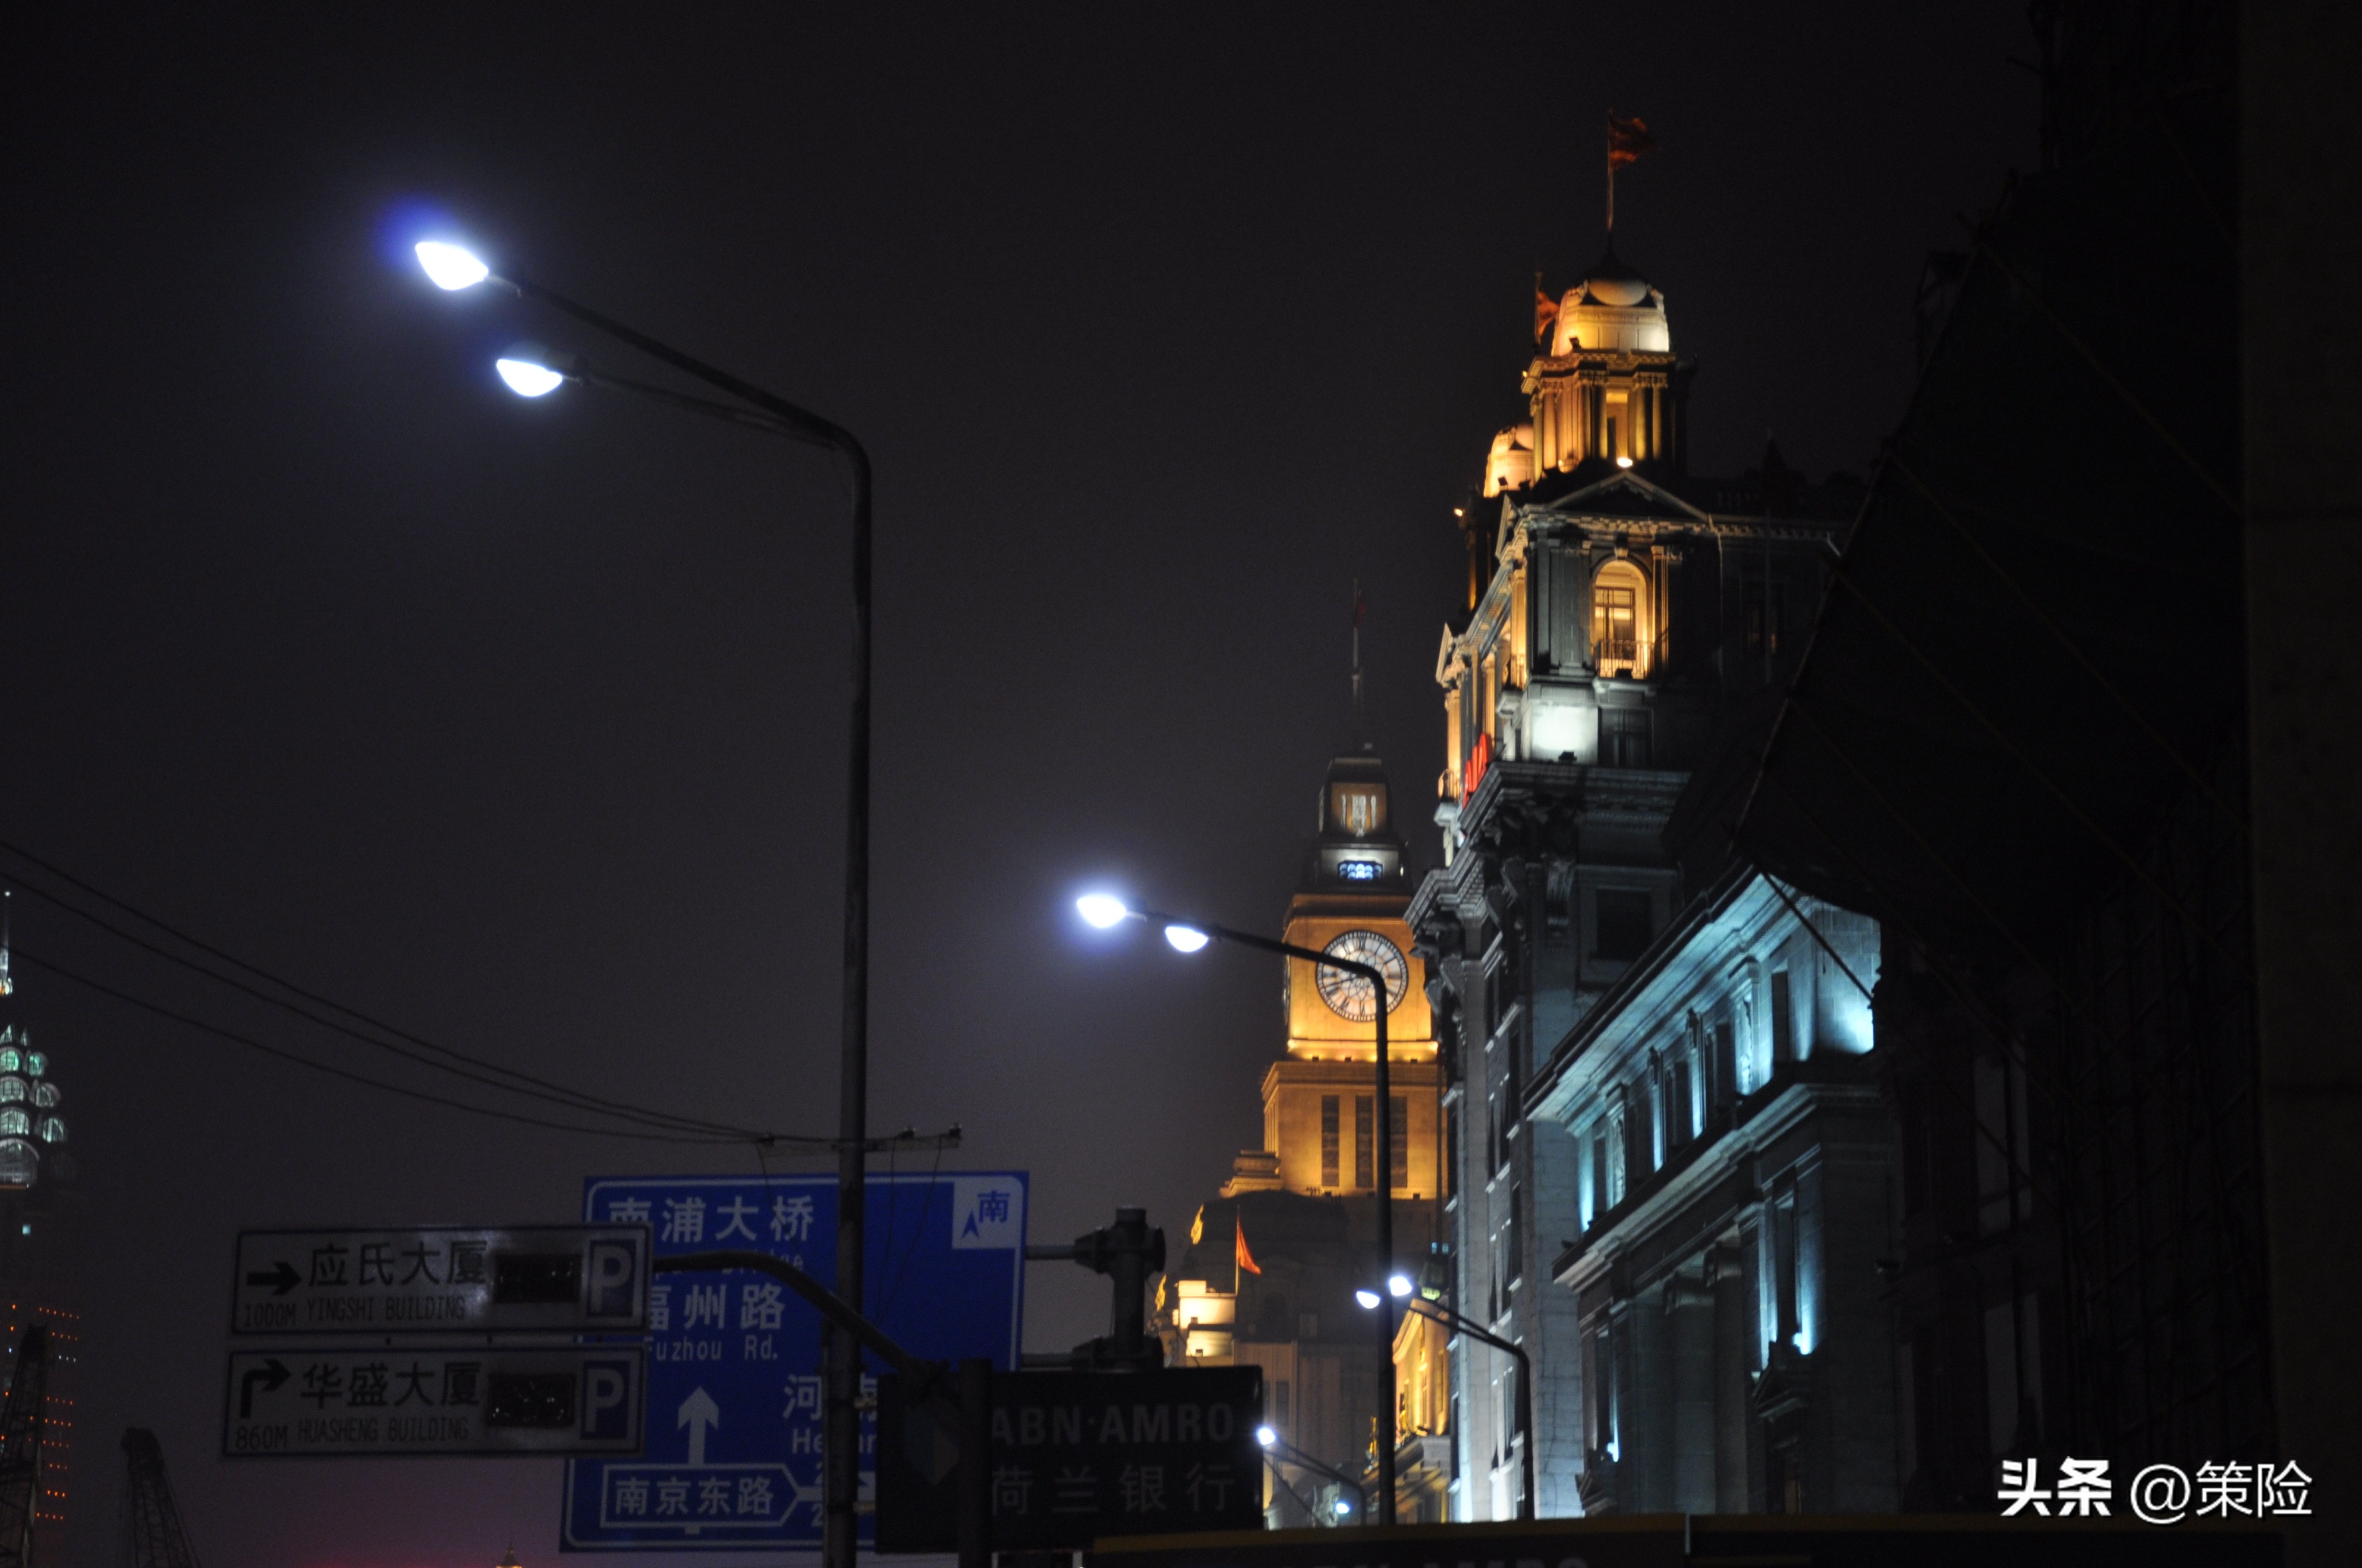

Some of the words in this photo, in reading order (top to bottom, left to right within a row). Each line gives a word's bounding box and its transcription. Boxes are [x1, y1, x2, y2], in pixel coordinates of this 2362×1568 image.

[609, 1194, 814, 1243] 南浦大桥
[978, 1191, 1009, 1223] 南
[309, 1241, 488, 1287] 应氏大厦
[595, 1245, 633, 1314] P
[244, 1303, 297, 1327] 1000M
[307, 1297, 374, 1323] YINGSHI
[386, 1296, 466, 1321] BUILDING
[744, 1334, 778, 1361] Rd.
[300, 1361, 482, 1409] 华盛大厦
[586, 1368, 624, 1433] P
[237, 1425, 288, 1450] 860M
[298, 1418, 379, 1443] HUASHENG
[388, 1417, 470, 1441] BUILDING
[615, 1476, 774, 1516] 南京东路
[992, 1461, 1235, 1515] 荷兰银行
